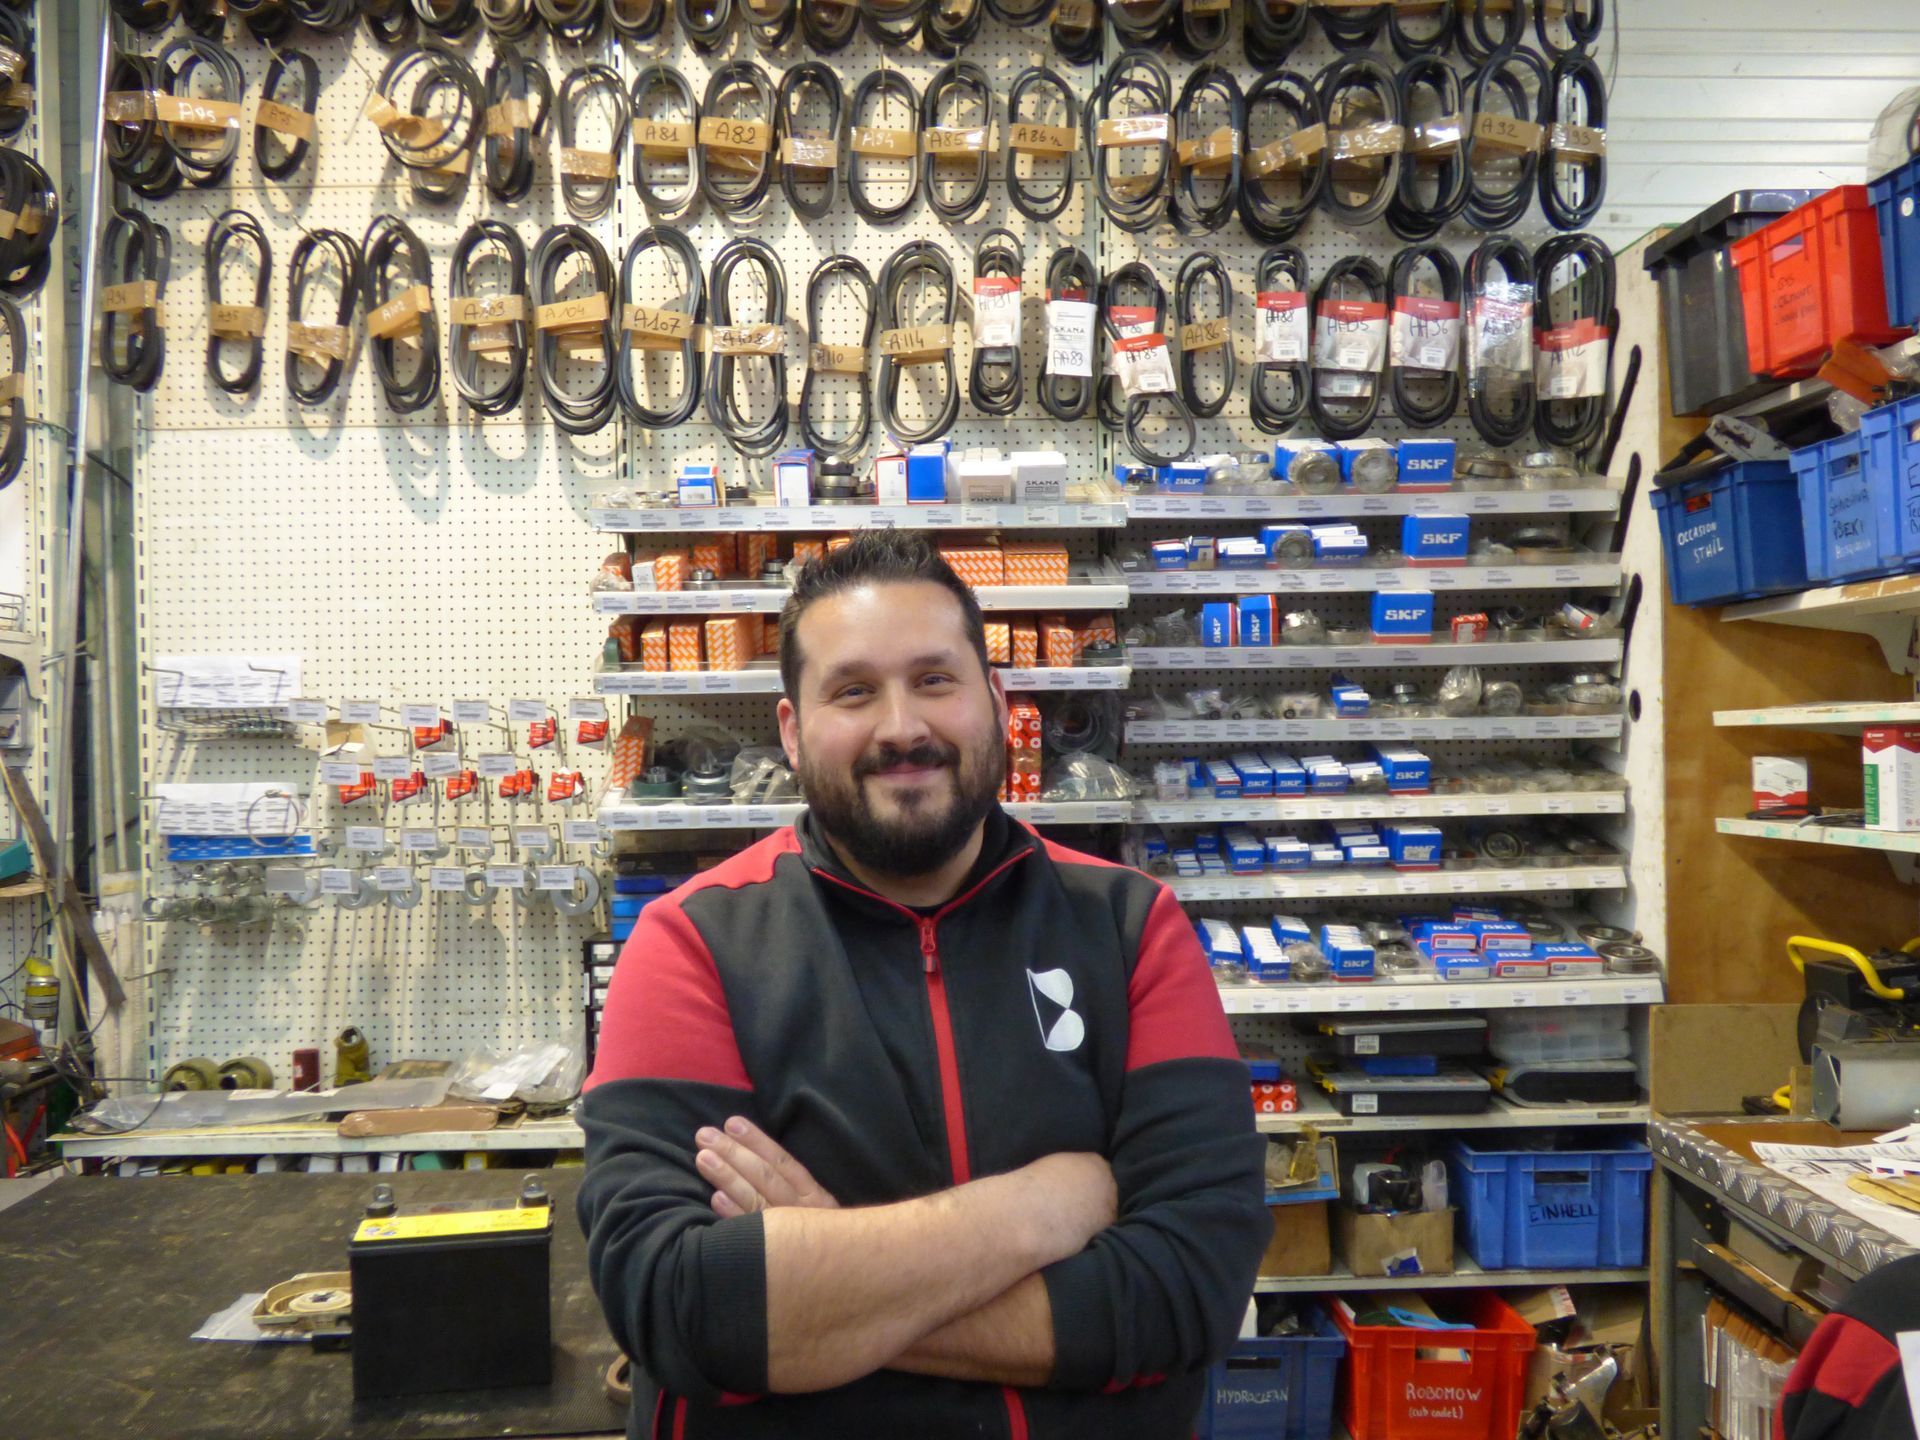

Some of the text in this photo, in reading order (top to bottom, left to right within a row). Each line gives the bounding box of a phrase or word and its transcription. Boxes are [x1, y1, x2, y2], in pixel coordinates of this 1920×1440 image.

[645, 126, 680, 142] A81
[715, 122, 756, 144] A82
[1481, 118, 1520, 138] A92
[633, 309, 680, 332] A107
[1052, 350, 1084, 367] AA83
[1407, 459, 1448, 470] SKF
[1421, 533, 1463, 544] SKF
[1676, 521, 1717, 547] OCCASION
[1160, 556, 1183, 564] SKF
[1384, 609, 1427, 620] SKF
[1213, 617, 1222, 643] SKF
[1251, 613, 1260, 642] SKF
[1395, 771, 1425, 780] SKF
[1236, 857, 1260, 865] SKF
[1528, 1204, 1598, 1223] EINHELL
[1216, 1386, 1289, 1405] HYDROCLEAN
